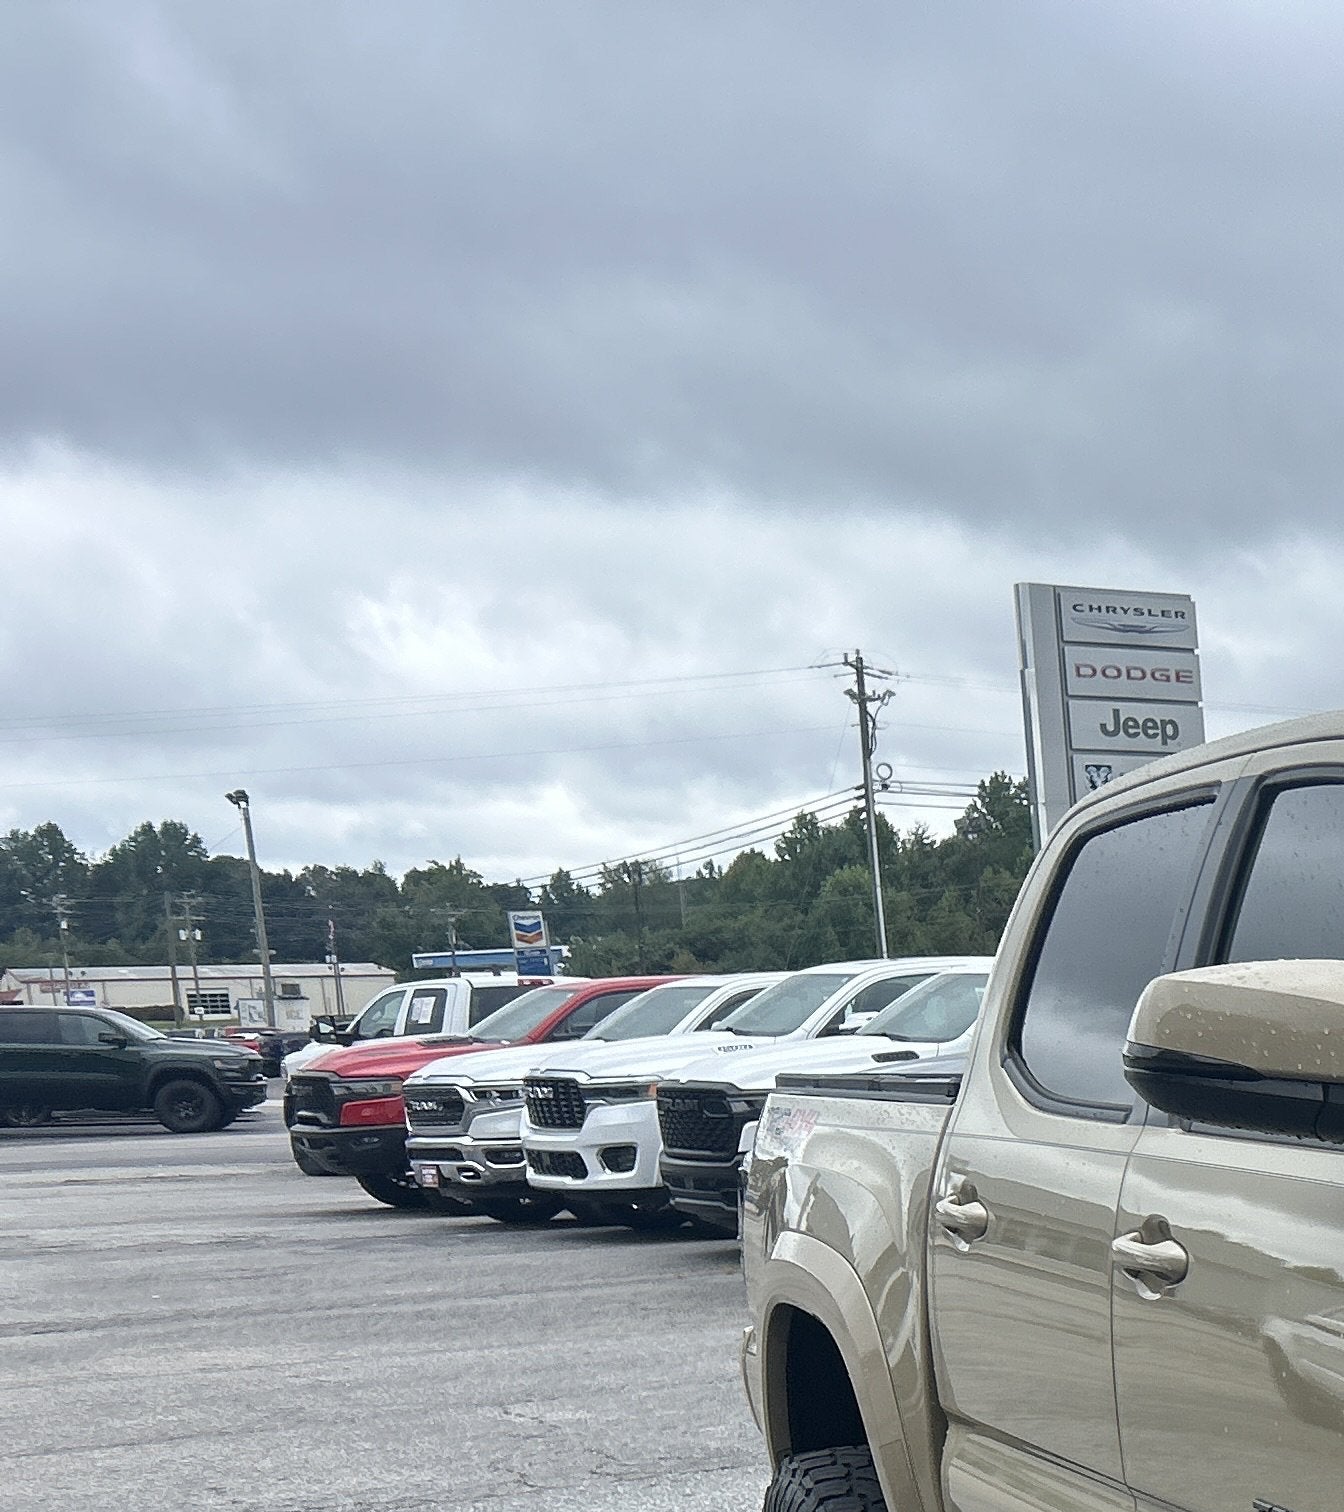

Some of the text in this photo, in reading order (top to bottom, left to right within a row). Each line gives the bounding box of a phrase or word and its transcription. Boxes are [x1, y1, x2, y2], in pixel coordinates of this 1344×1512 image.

[1072, 603, 1186, 620] CHRYSLER
[1074, 663, 1194, 685] DODGE
[1099, 708, 1180, 746] Jeep
